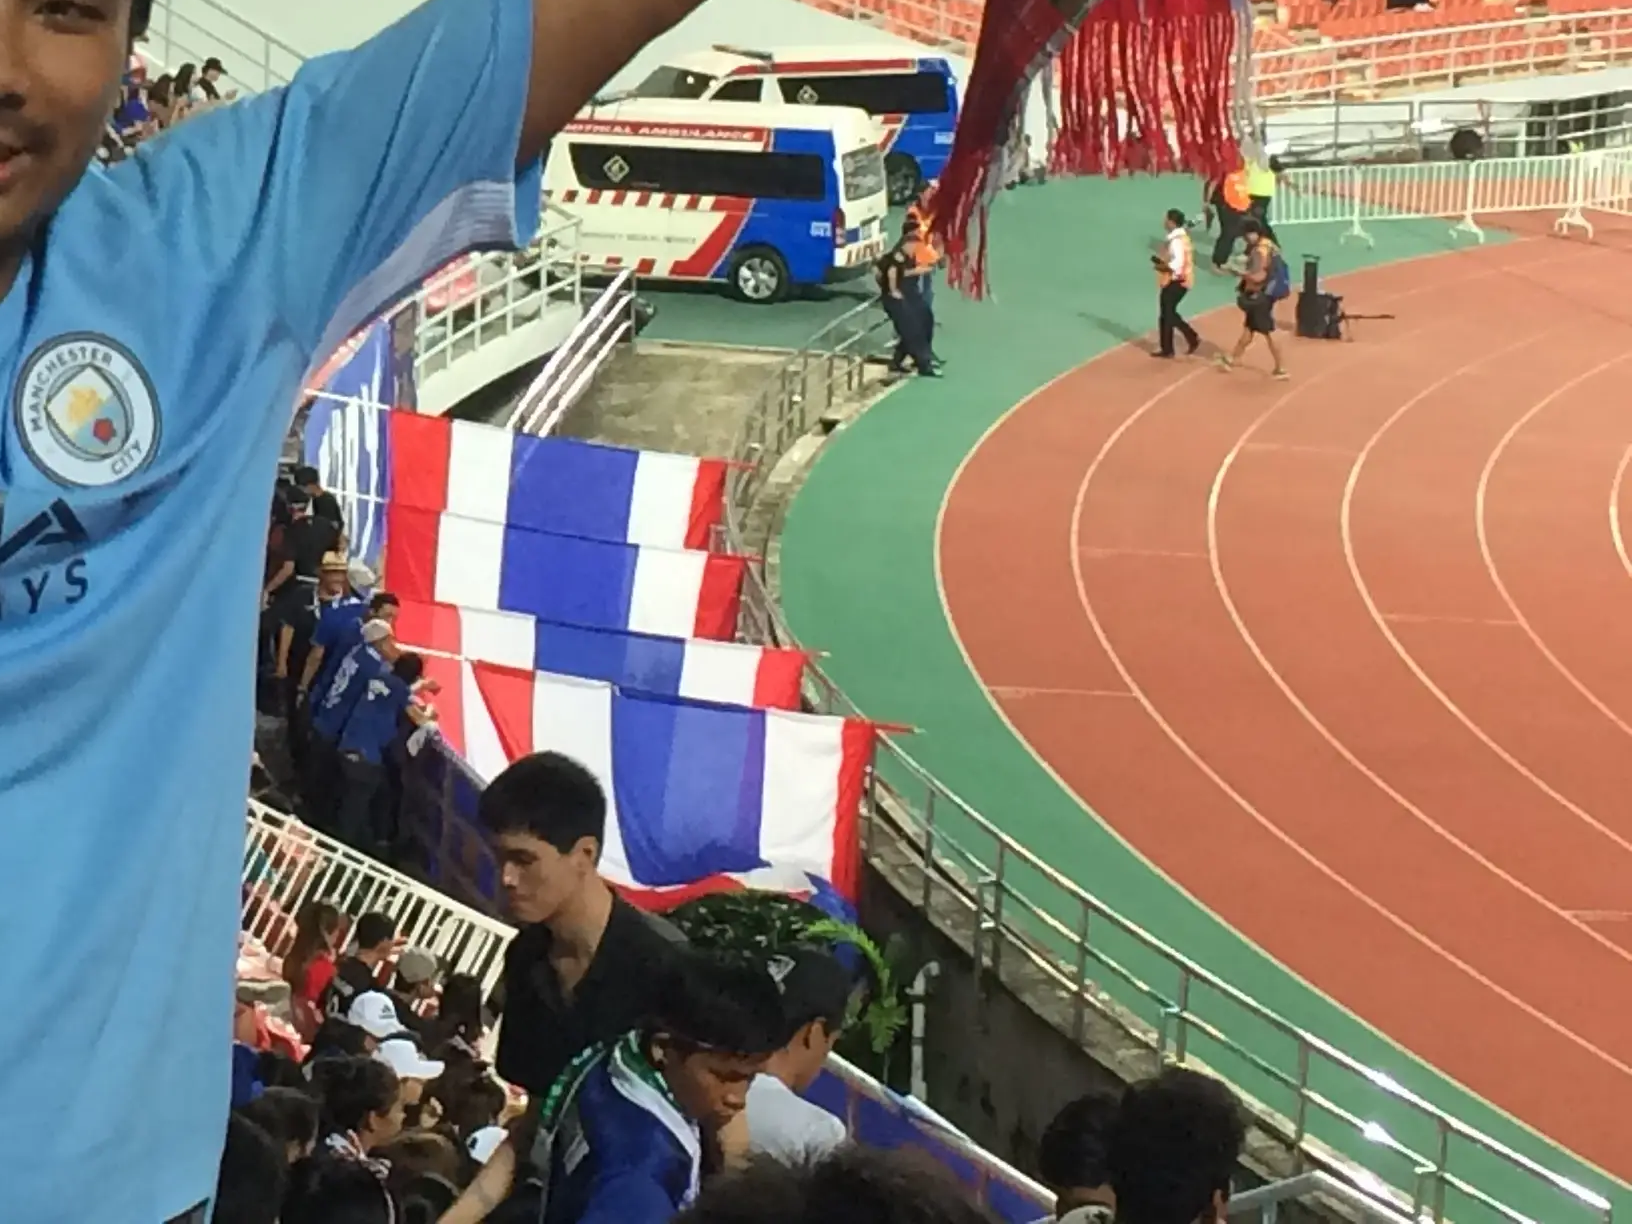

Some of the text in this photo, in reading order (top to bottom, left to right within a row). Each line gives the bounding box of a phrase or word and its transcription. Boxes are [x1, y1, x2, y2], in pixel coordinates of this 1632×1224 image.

[638, 126, 755, 141] AMBULANCE
[28, 345, 113, 433] MANCHESTER
[110, 438, 142, 476] CITY
